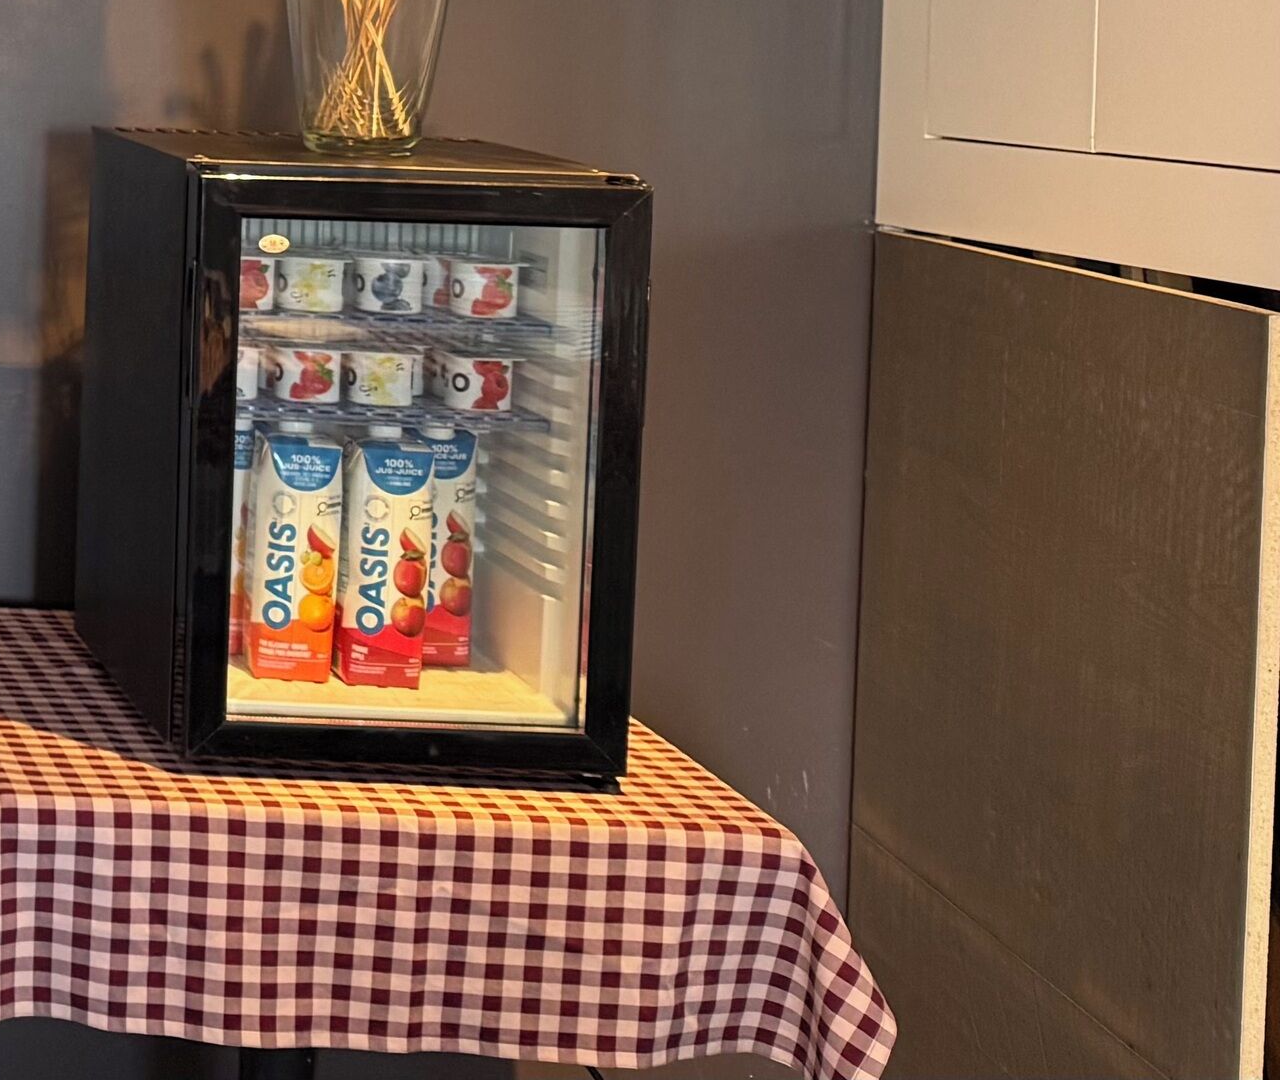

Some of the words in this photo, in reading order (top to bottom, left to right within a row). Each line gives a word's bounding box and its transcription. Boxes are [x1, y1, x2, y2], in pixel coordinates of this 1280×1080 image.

[291, 454, 321, 464] 100%
[384, 458, 414, 469] 100%
[262, 520, 297, 630] OASIS
[355, 526, 390, 635] OASIS
